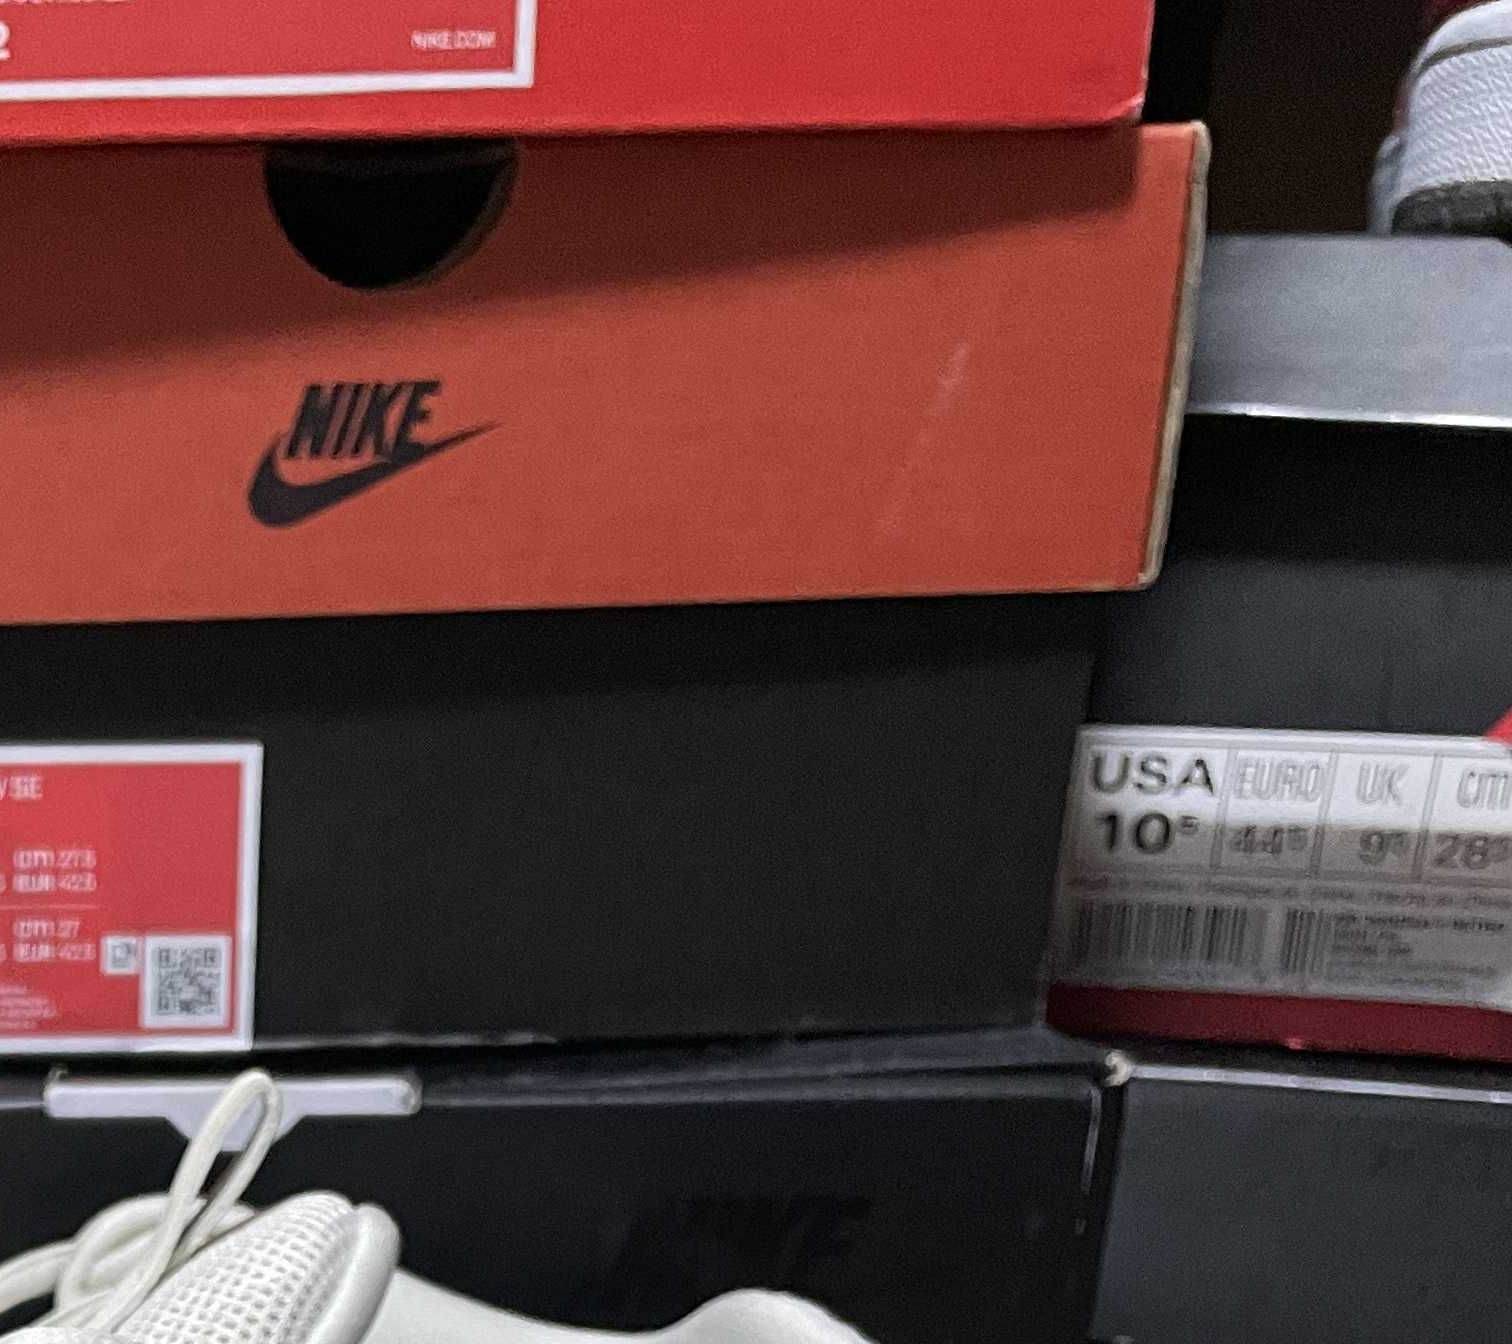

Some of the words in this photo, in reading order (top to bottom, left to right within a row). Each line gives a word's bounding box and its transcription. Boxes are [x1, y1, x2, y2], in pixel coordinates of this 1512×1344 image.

[284, 380, 442, 461] NIKE
[9, 774, 44, 800] SE
[1091, 752, 1216, 796] USA
[1238, 757, 1323, 801] EURO
[1355, 760, 1410, 805] UK
